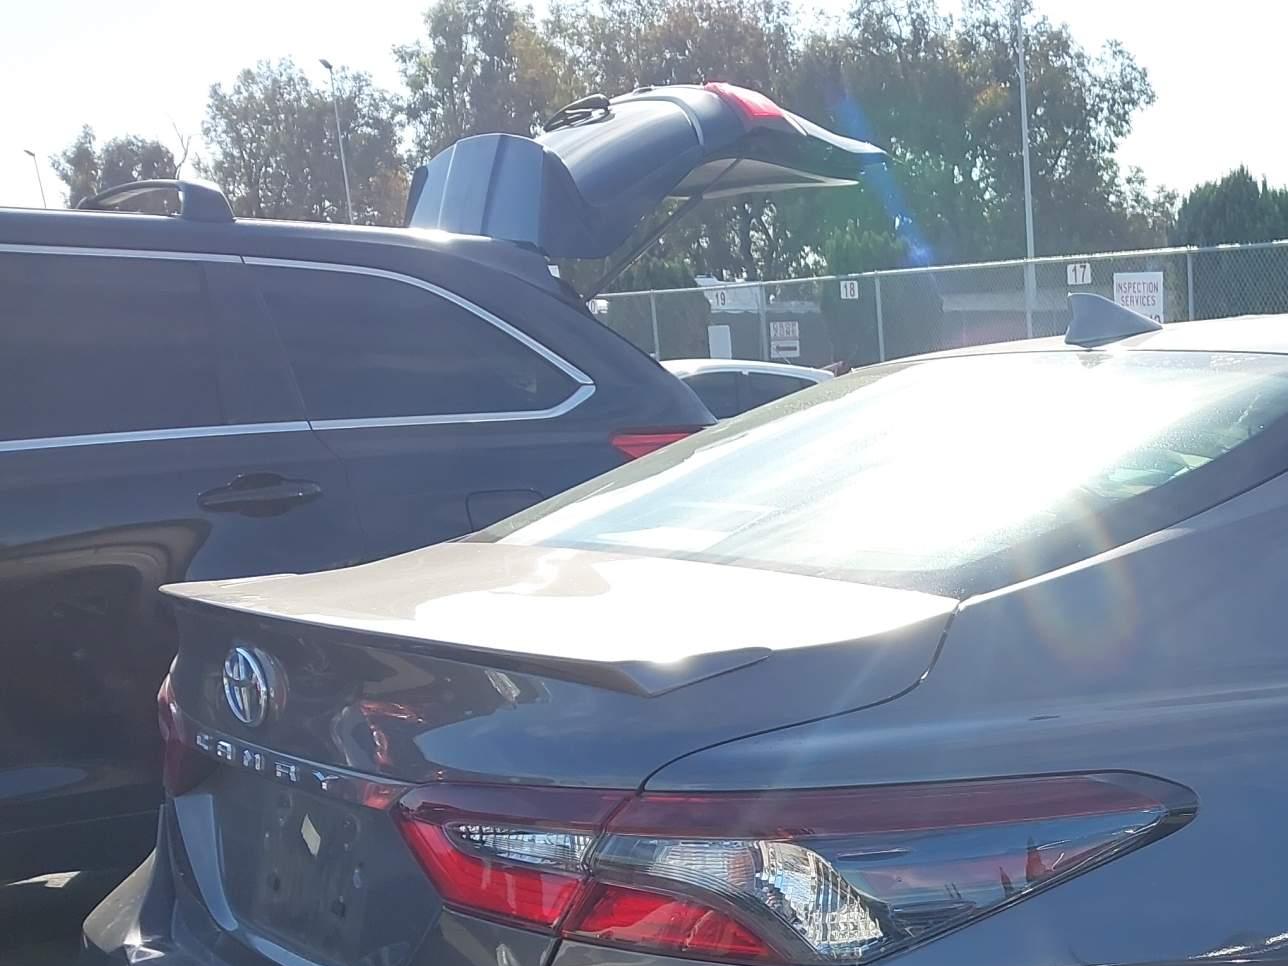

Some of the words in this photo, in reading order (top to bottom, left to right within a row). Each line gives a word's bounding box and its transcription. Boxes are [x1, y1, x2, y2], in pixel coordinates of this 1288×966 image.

[1072, 264, 1087, 283] 17
[843, 281, 856, 297] 18
[1115, 281, 1159, 293] INSPECTION
[714, 291, 726, 305] 19
[1120, 295, 1156, 307] SERVICES
[196, 734, 340, 791] CAMRY
